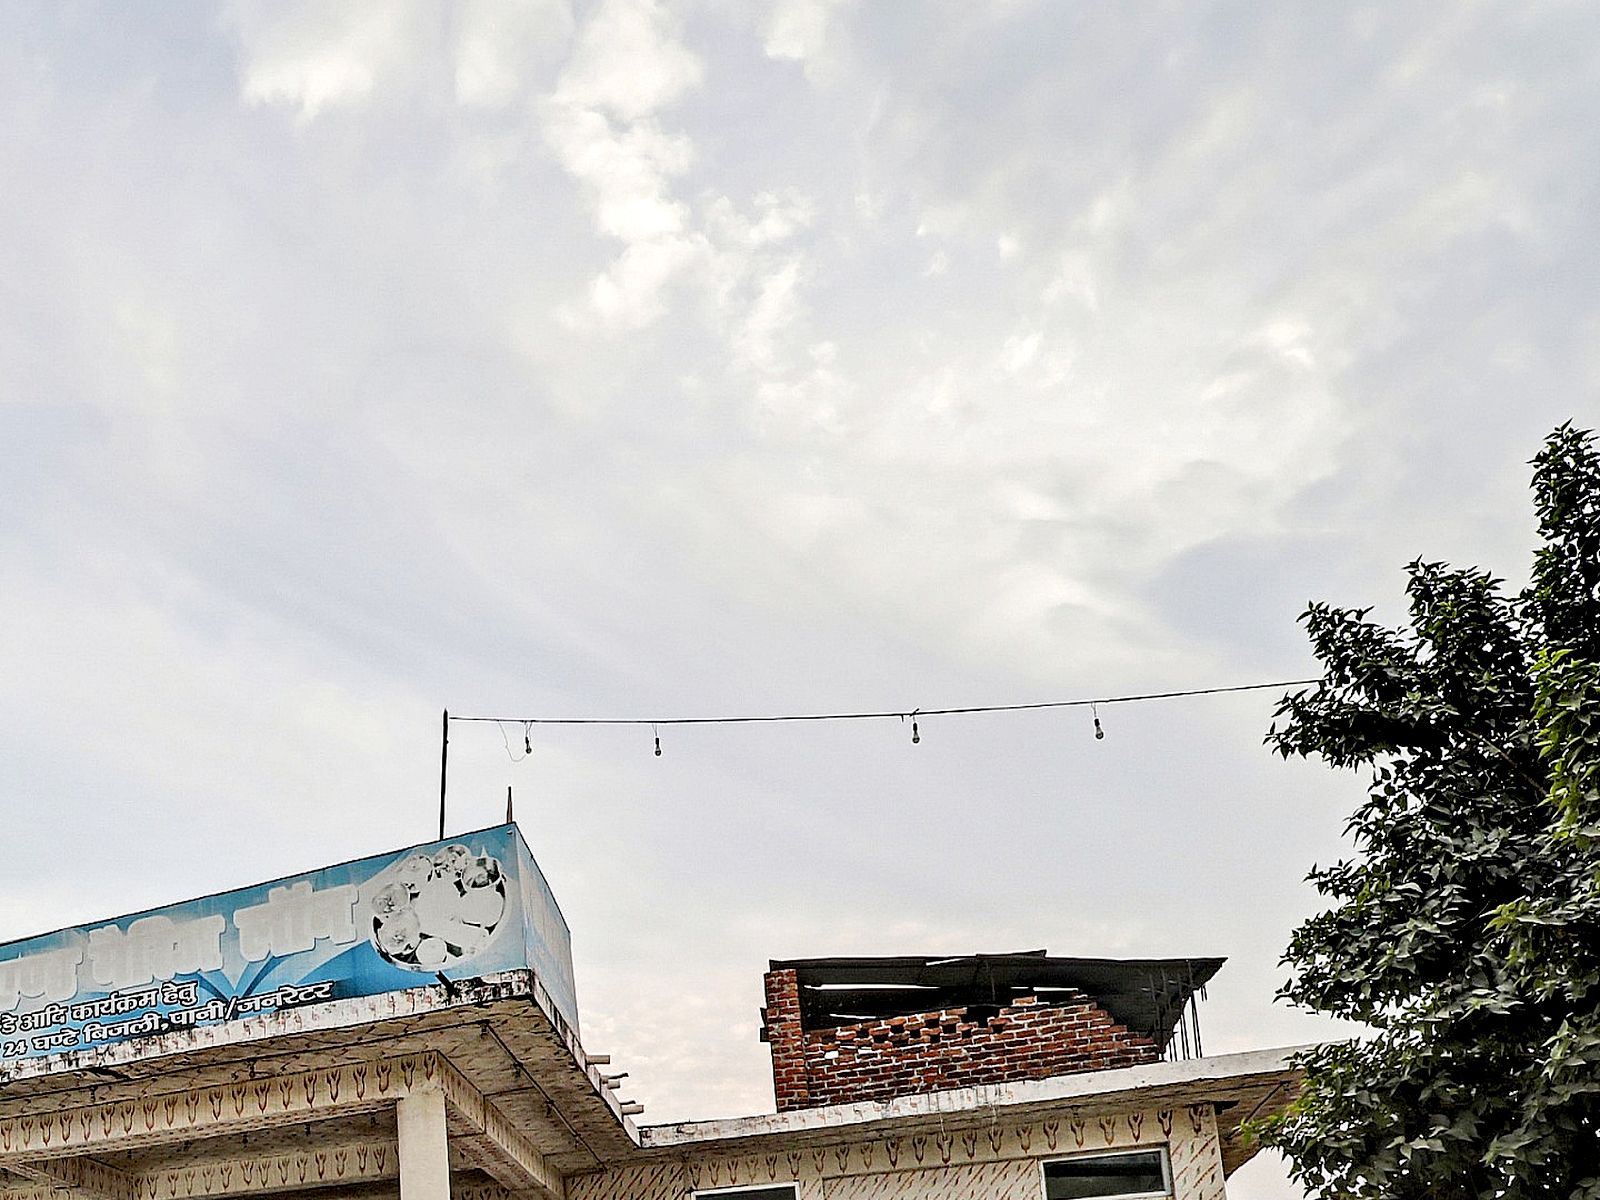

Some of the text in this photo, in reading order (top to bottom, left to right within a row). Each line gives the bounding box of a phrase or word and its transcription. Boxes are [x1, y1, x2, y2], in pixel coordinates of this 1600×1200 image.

[19, 1004, 68, 1032] आदि
[71, 987, 160, 1022] कार्यक्रम
[2, 1040, 29, 1058] 24
